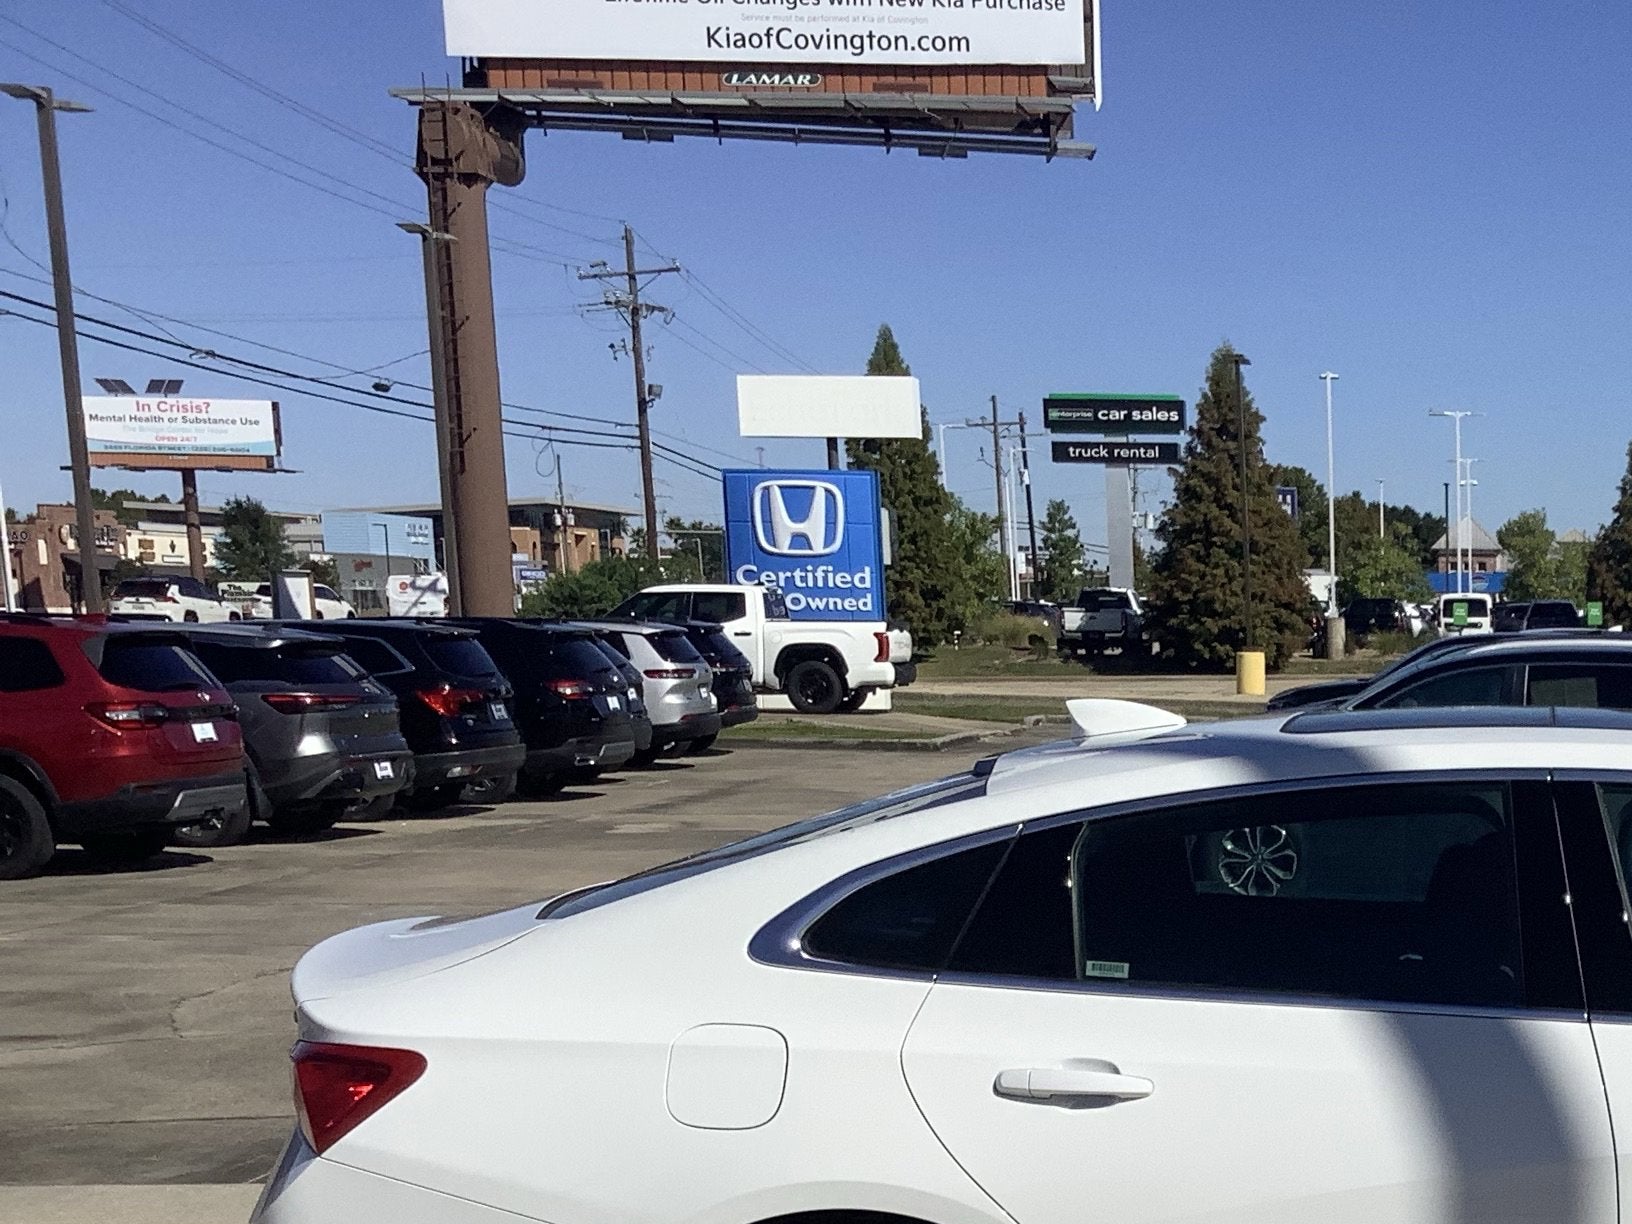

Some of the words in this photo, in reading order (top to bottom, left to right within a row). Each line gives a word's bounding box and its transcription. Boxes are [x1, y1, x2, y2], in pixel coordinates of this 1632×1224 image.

[972, 0, 1066, 11] Purchase
[740, 13, 770, 22] Service
[772, 14, 793, 22] must
[794, 14, 805, 22] be
[887, 16, 929, 25] Covington
[706, 26, 970, 56] KiaofCovington.com
[730, 74, 812, 85] LAMAR
[136, 401, 151, 412] In
[156, 401, 211, 414] Crisis?
[1097, 408, 1128, 421] car
[1131, 406, 1180, 422] sales
[89, 413, 126, 423] Mental
[129, 414, 165, 424] Health
[182, 416, 237, 426] Substance
[240, 418, 260, 426] Use
[1068, 445, 1109, 458] truck
[1114, 446, 1159, 459] rental
[735, 564, 872, 588] Certified
